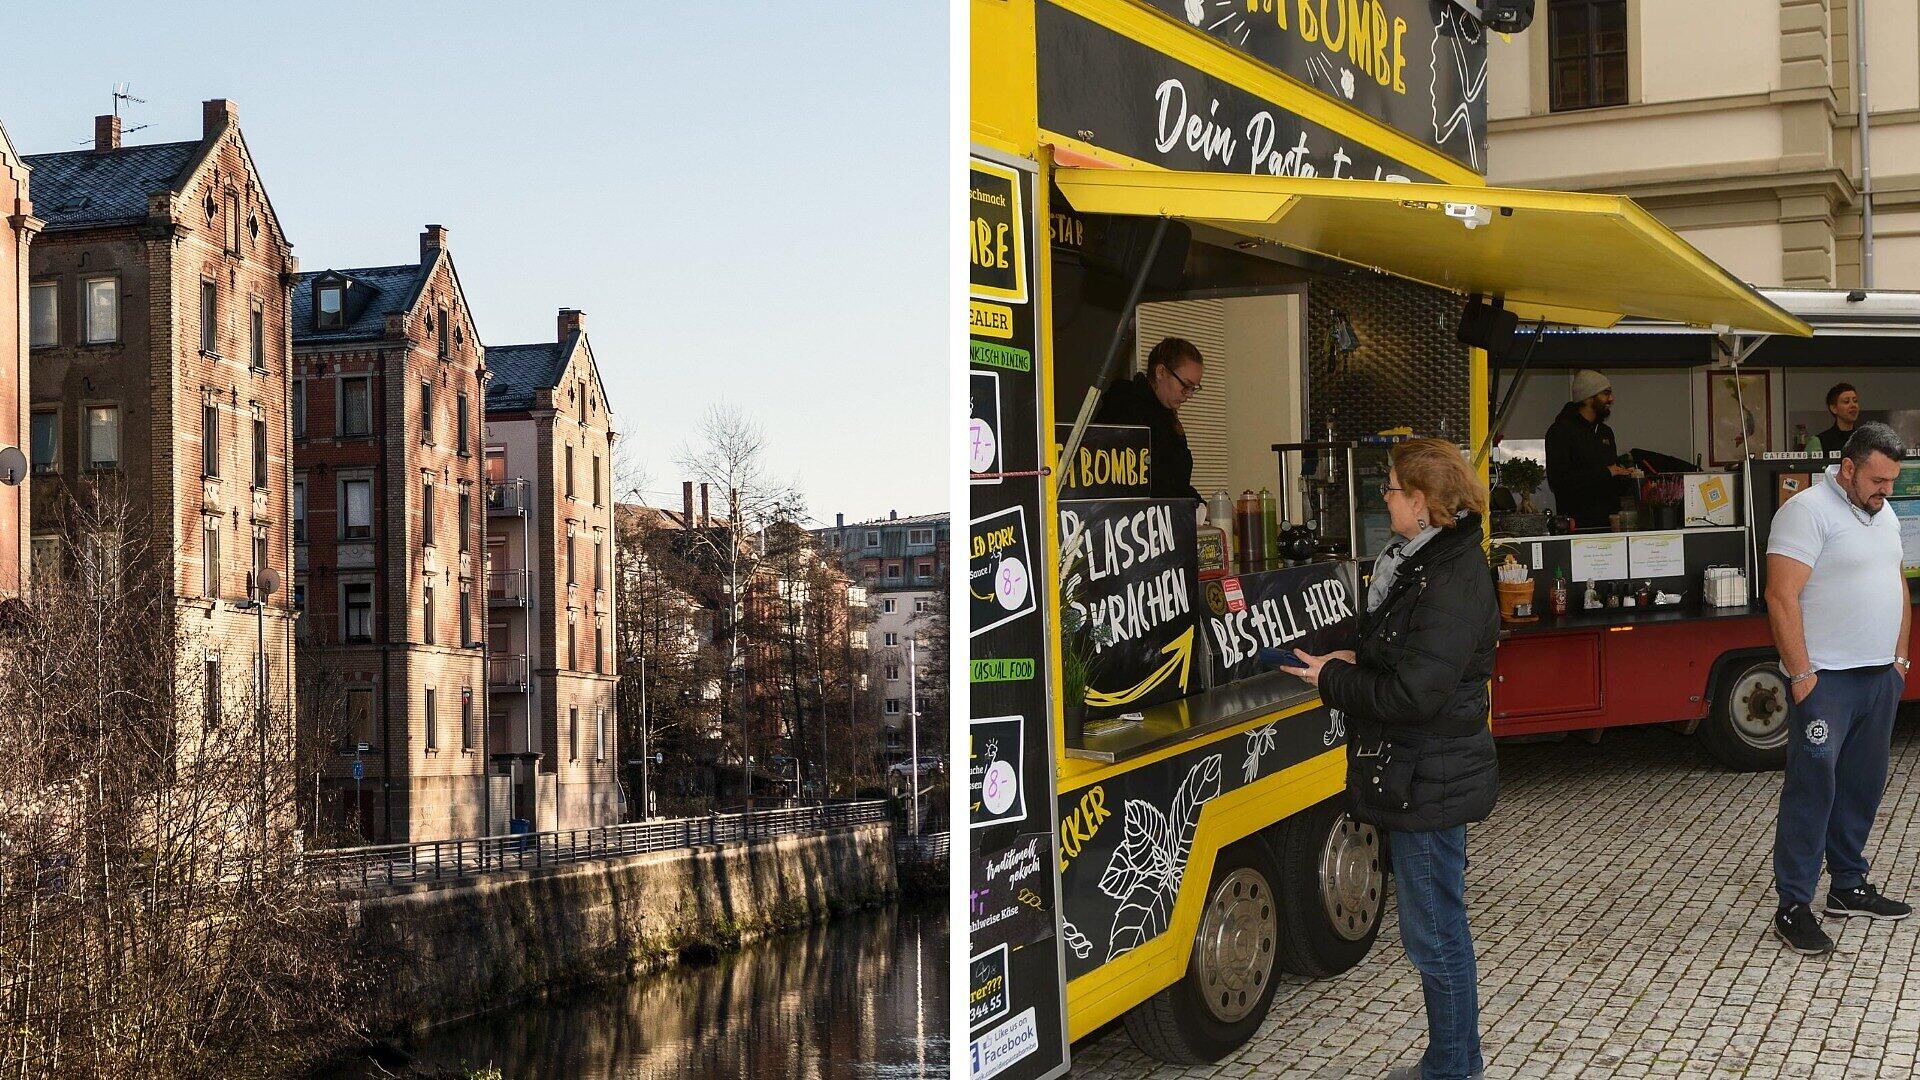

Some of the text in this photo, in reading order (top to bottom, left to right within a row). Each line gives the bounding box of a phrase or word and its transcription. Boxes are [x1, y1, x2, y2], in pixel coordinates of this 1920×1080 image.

[1298, 0, 1407, 94] BOMBE
[1154, 78, 1237, 166] Dein
[1246, 111, 1318, 178] Pasta
[1001, 350, 1029, 370] DINING
[1080, 446, 1149, 487] BOMBE
[1763, 452, 1807, 460] CATERING
[987, 525, 1016, 553] PORK
[1084, 505, 1176, 582] LASSEN
[1089, 568, 1190, 654] KRACHEN
[1302, 579, 1354, 631] HIER
[974, 661, 1032, 680] CASUAL FOOD
[1813, 727, 1823, 737] 23
[985, 837, 1038, 882] traditionell
[1001, 906, 1019, 920] Käse
[990, 993, 1002, 1011] 55
[984, 1025, 1034, 1065] Facebook
[994, 1017, 1027, 1041] Like us on
